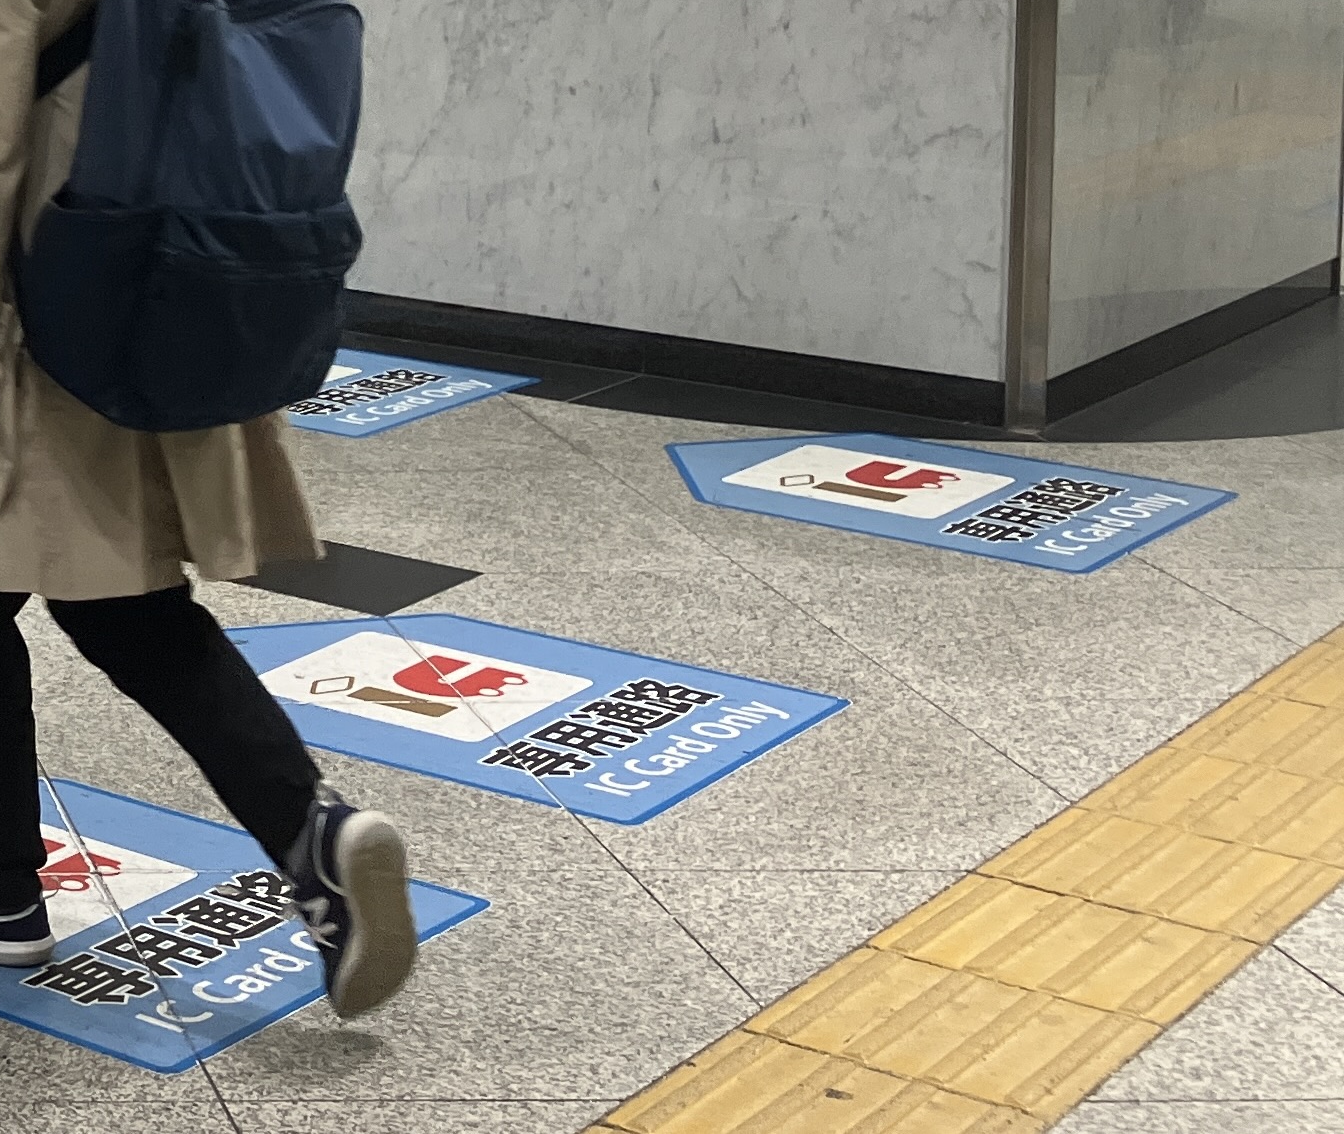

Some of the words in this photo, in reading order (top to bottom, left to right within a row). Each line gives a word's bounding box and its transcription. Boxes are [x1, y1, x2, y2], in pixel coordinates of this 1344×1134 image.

[286, 368, 452, 417] 専用通路
[335, 412, 381, 426] IC
[366, 395, 435, 416] Card
[421, 379, 493, 400] Only
[938, 476, 1130, 543] 専用通路
[1034, 538, 1088, 556] IC
[1062, 514, 1136, 543] Card
[1108, 492, 1190, 520] Only
[476, 676, 726, 780] 専用通路
[582, 771, 651, 797] IC
[623, 733, 718, 776] Card
[690, 699, 791, 741] Only
[19, 867, 298, 1007] 専用通路
[134, 999, 215, 1034] IC
[191, 946, 315, 1005] Card
